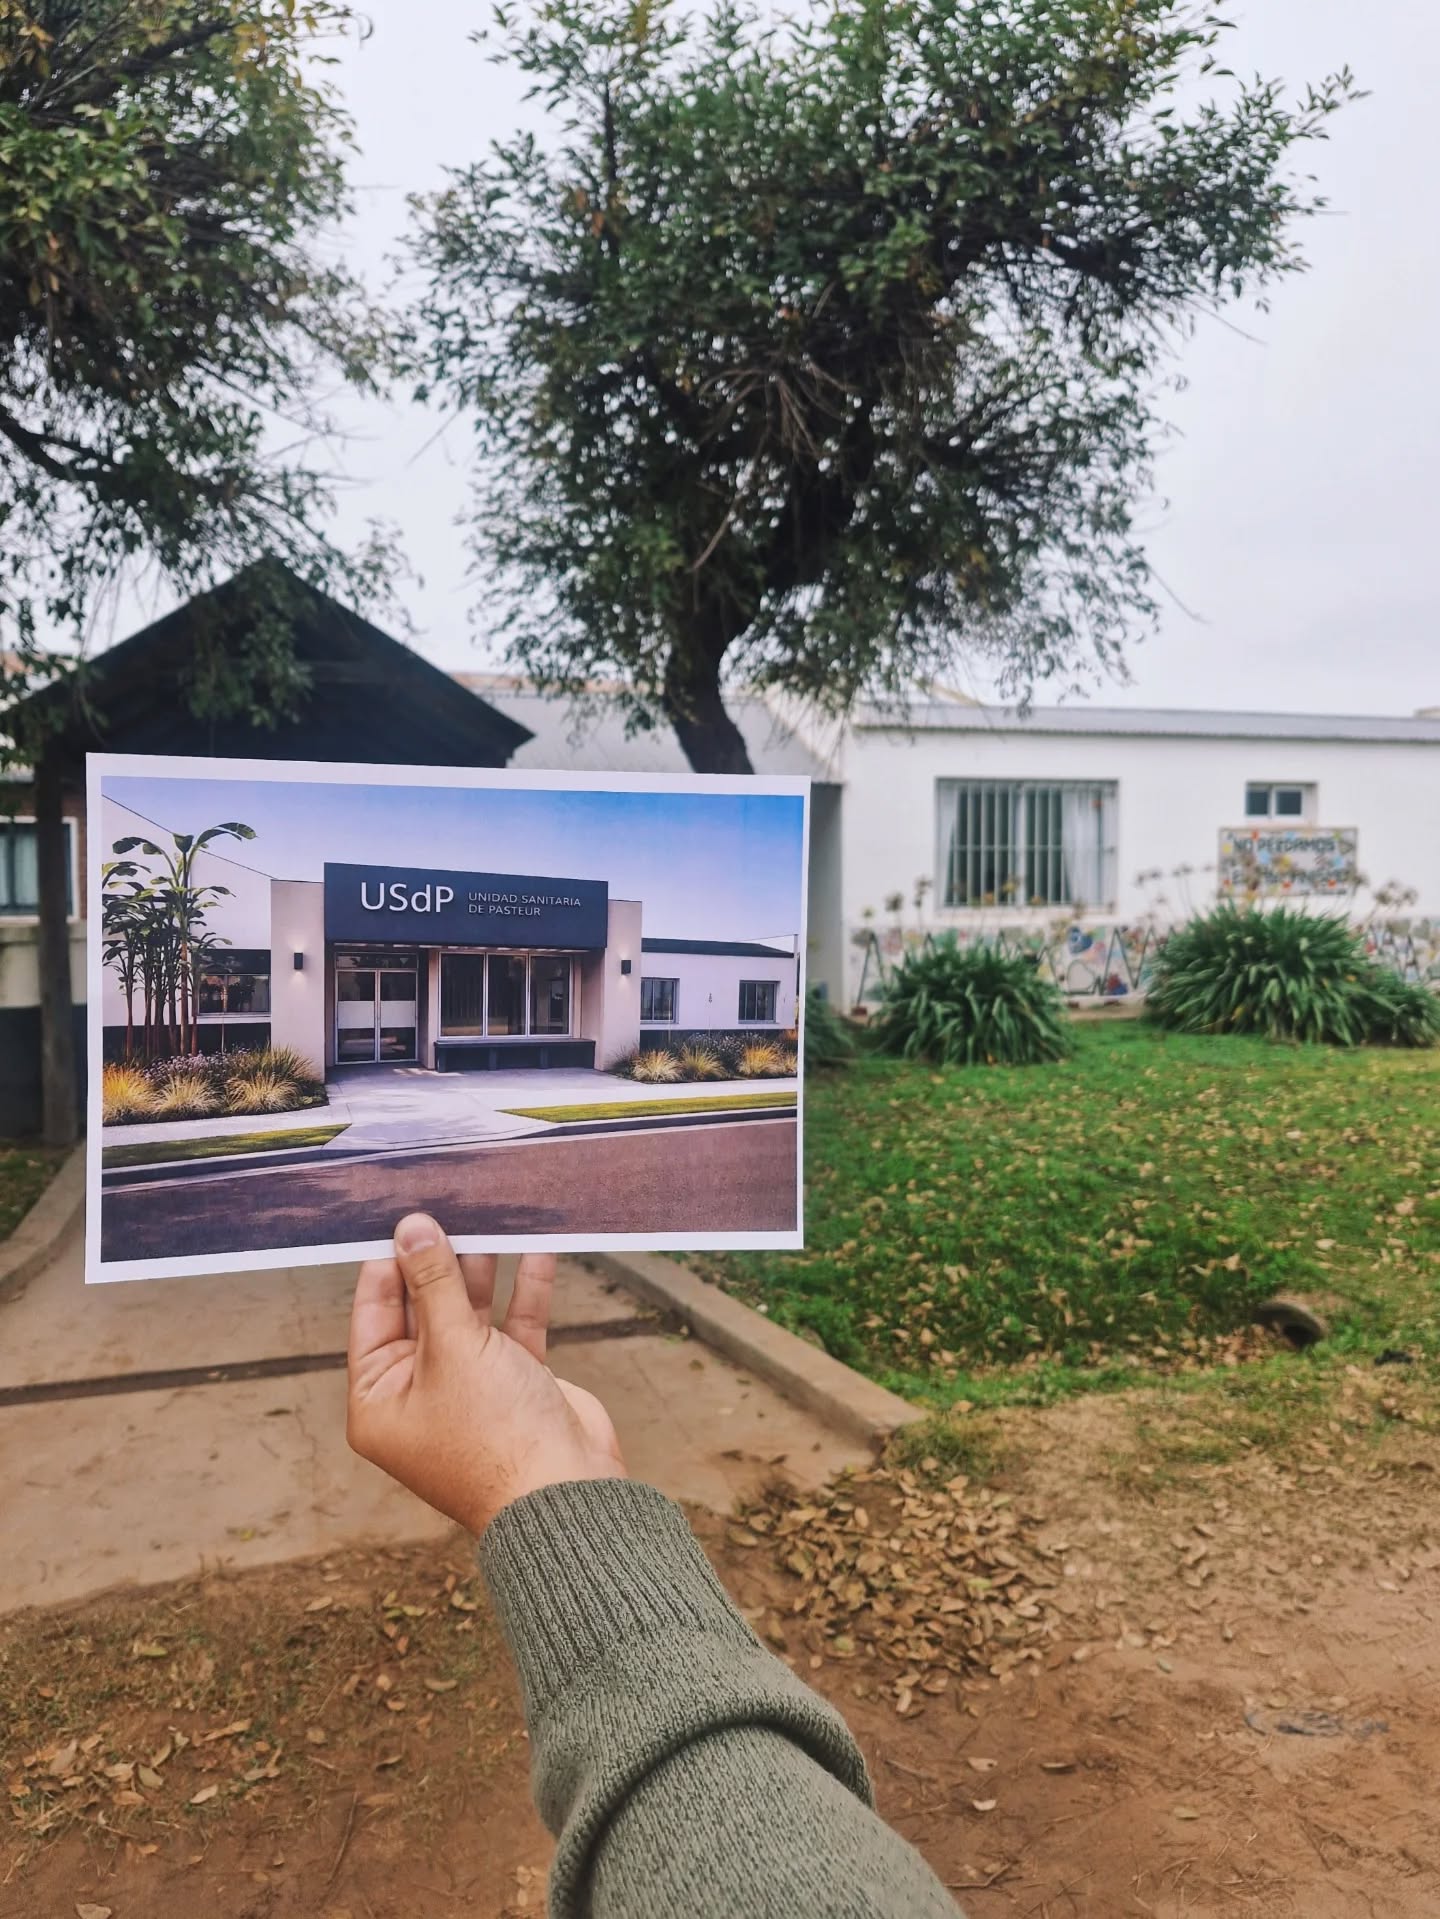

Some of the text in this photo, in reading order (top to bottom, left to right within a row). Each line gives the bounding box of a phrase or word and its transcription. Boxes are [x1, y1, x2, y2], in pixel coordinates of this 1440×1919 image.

[361, 881, 454, 913] USdP
[468, 892, 581, 907] UNIDAD SANITARIA
[468, 904, 541, 916] DE PASTEUR
